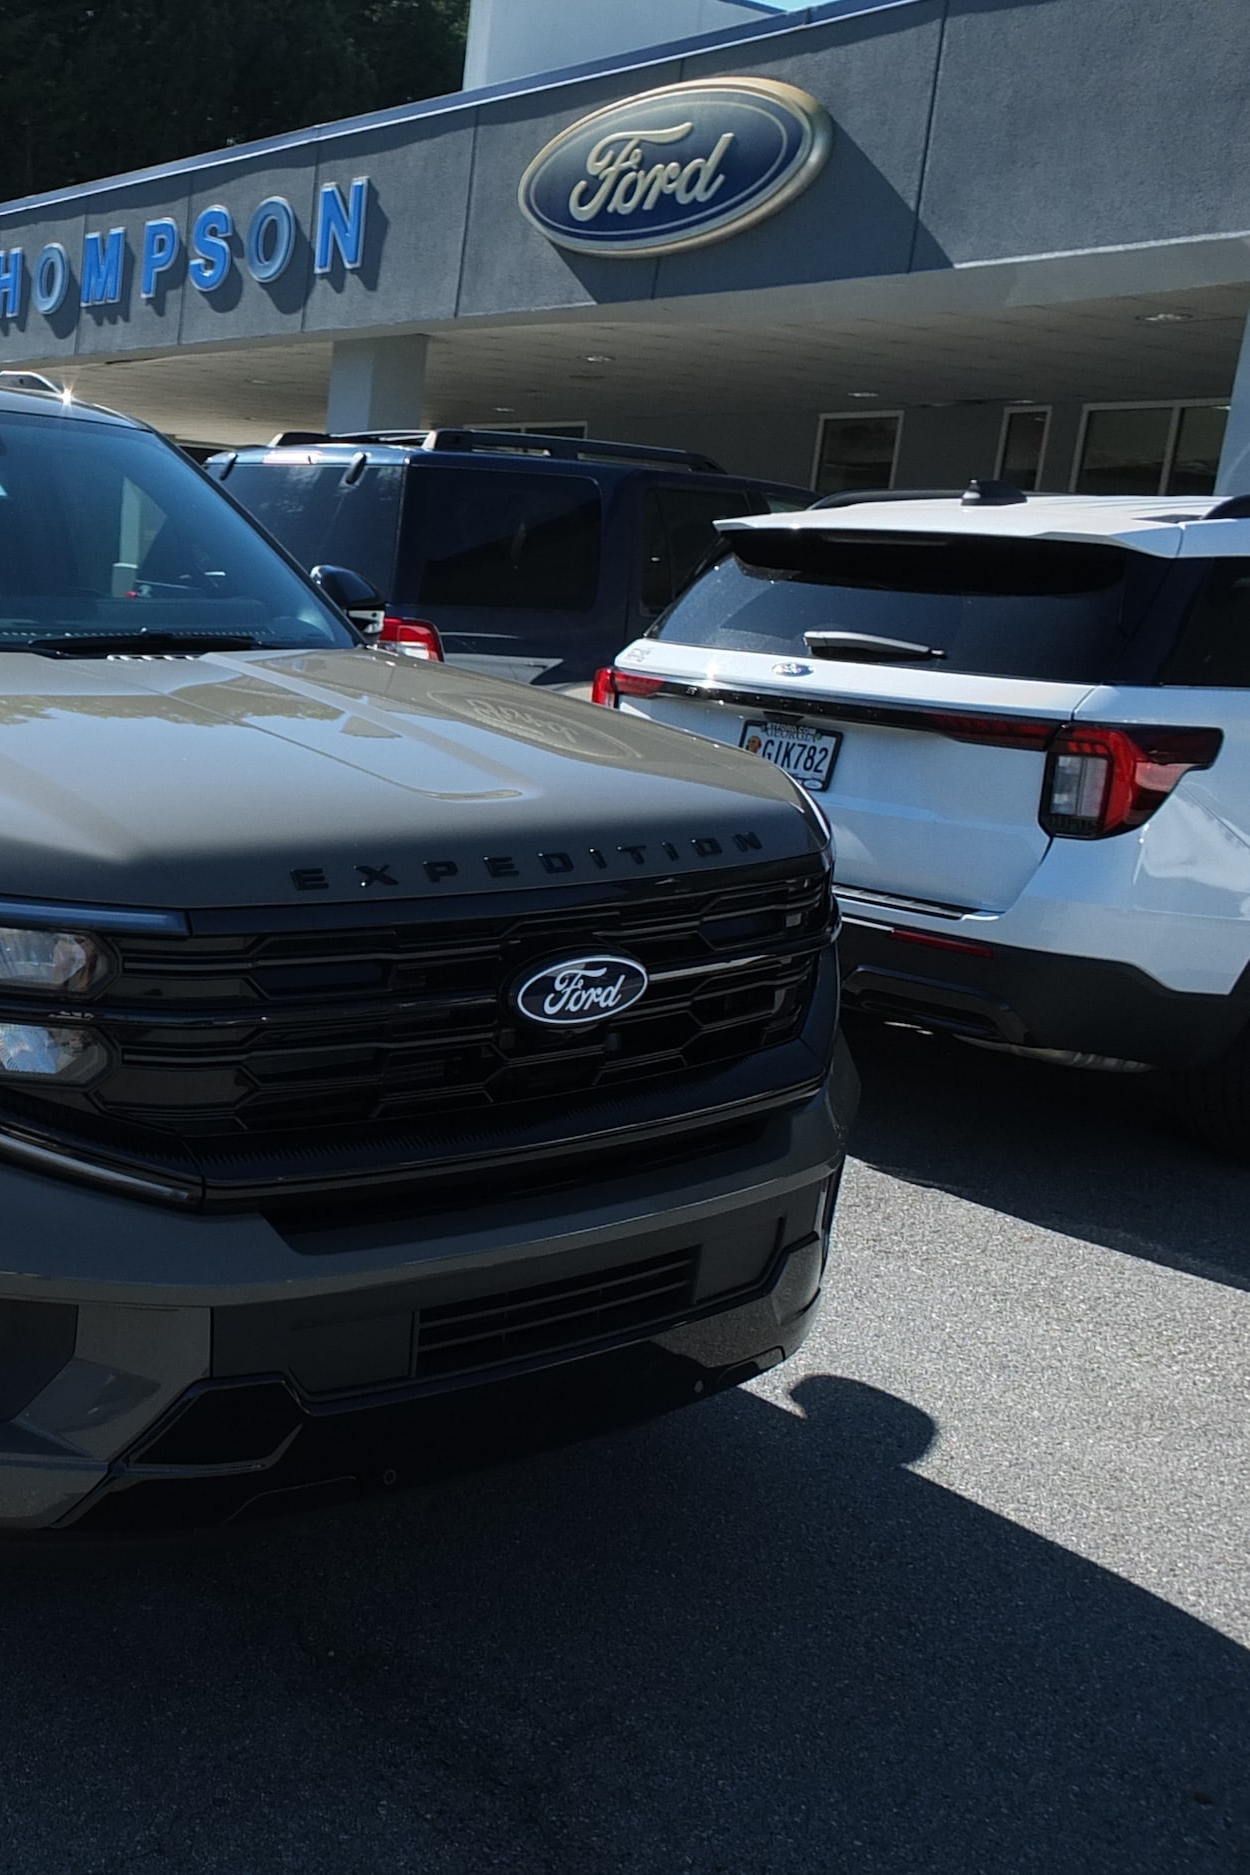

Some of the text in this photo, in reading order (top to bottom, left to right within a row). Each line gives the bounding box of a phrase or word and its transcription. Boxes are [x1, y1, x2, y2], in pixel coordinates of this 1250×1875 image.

[569, 121, 735, 222] Ford
[762, 739, 829, 773] GIK782
[290, 831, 764, 892] EXPEDITION
[543, 966, 626, 1015] Ford
